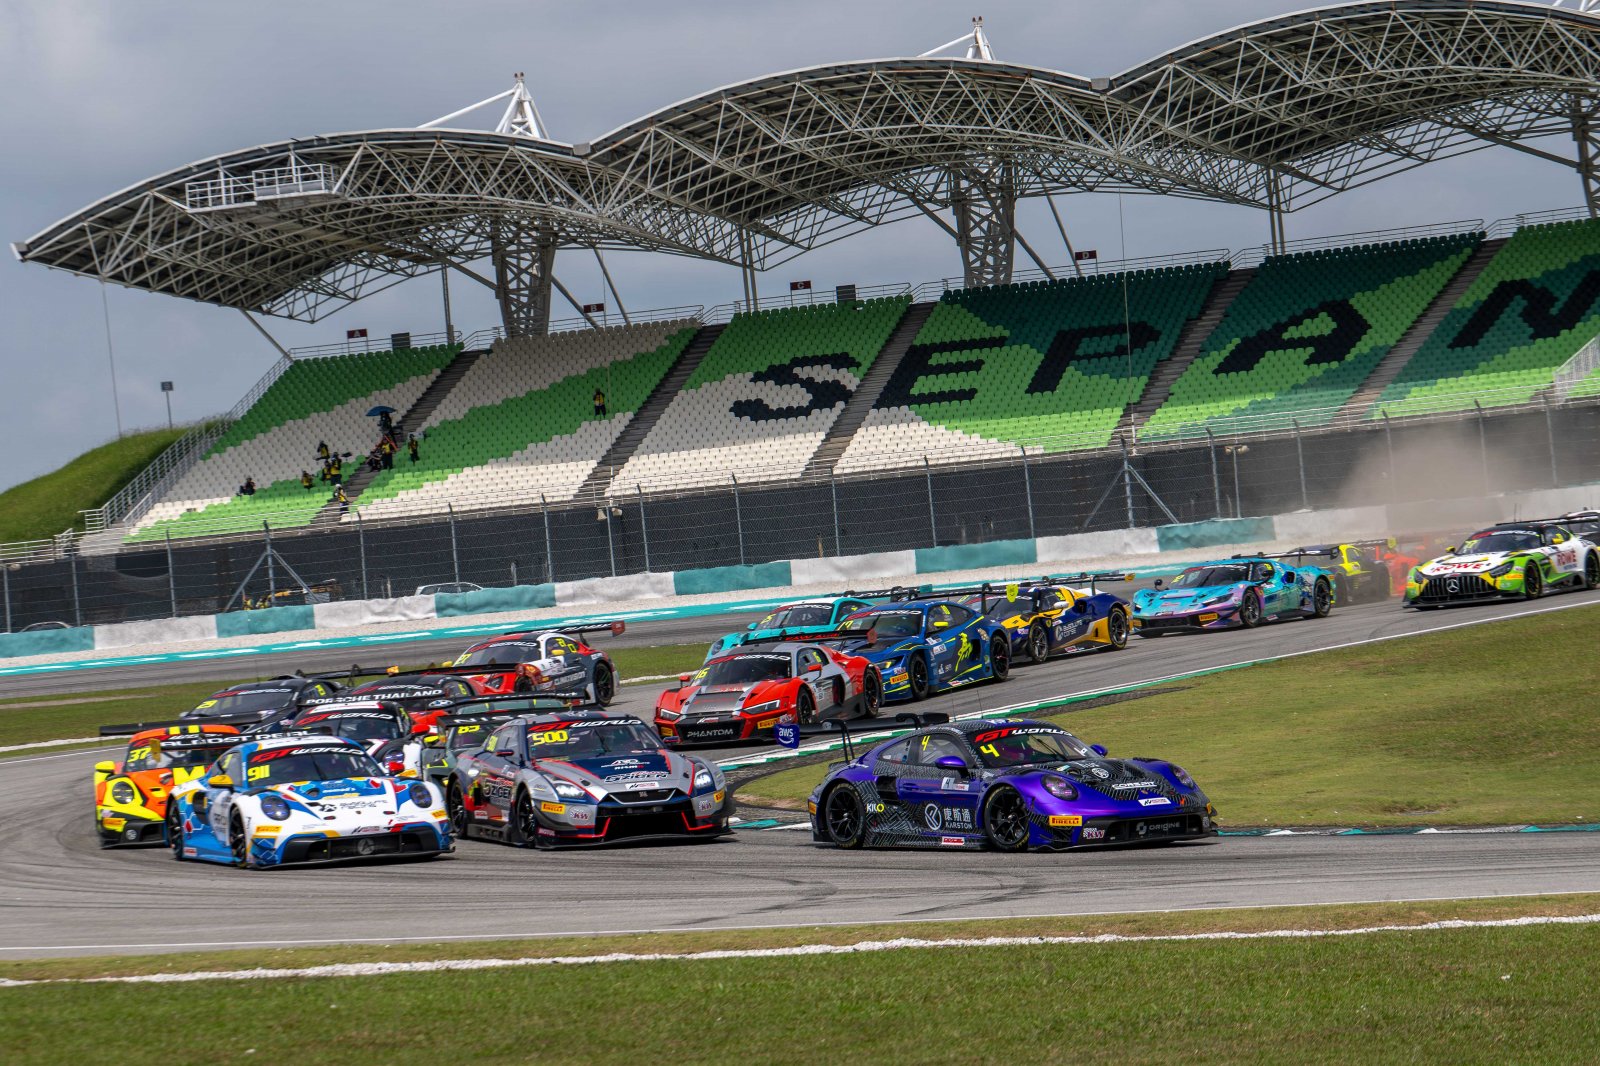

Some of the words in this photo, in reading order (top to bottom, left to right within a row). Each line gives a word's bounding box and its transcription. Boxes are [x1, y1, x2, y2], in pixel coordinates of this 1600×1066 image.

[1556, 548, 1578, 566] ROWE
[1433, 562, 1482, 573] ROWE
[305, 694, 371, 705] PORSCHE
[372, 689, 443, 701] THAILAND
[570, 719, 641, 728] WORLD
[531, 730, 569, 745] 500
[687, 728, 734, 738] PHANTOM
[778, 727, 794, 738] aws
[975, 727, 1019, 743] GT
[921, 735, 931, 751] 4
[127, 747, 152, 762] 37
[289, 747, 365, 755] WORLD
[979, 743, 1000, 757] 4
[247, 765, 270, 781] 911
[543, 803, 565, 812] PIRELLI
[945, 821, 973, 830] KARSTON
[1051, 818, 1080, 826] PIRELLI
